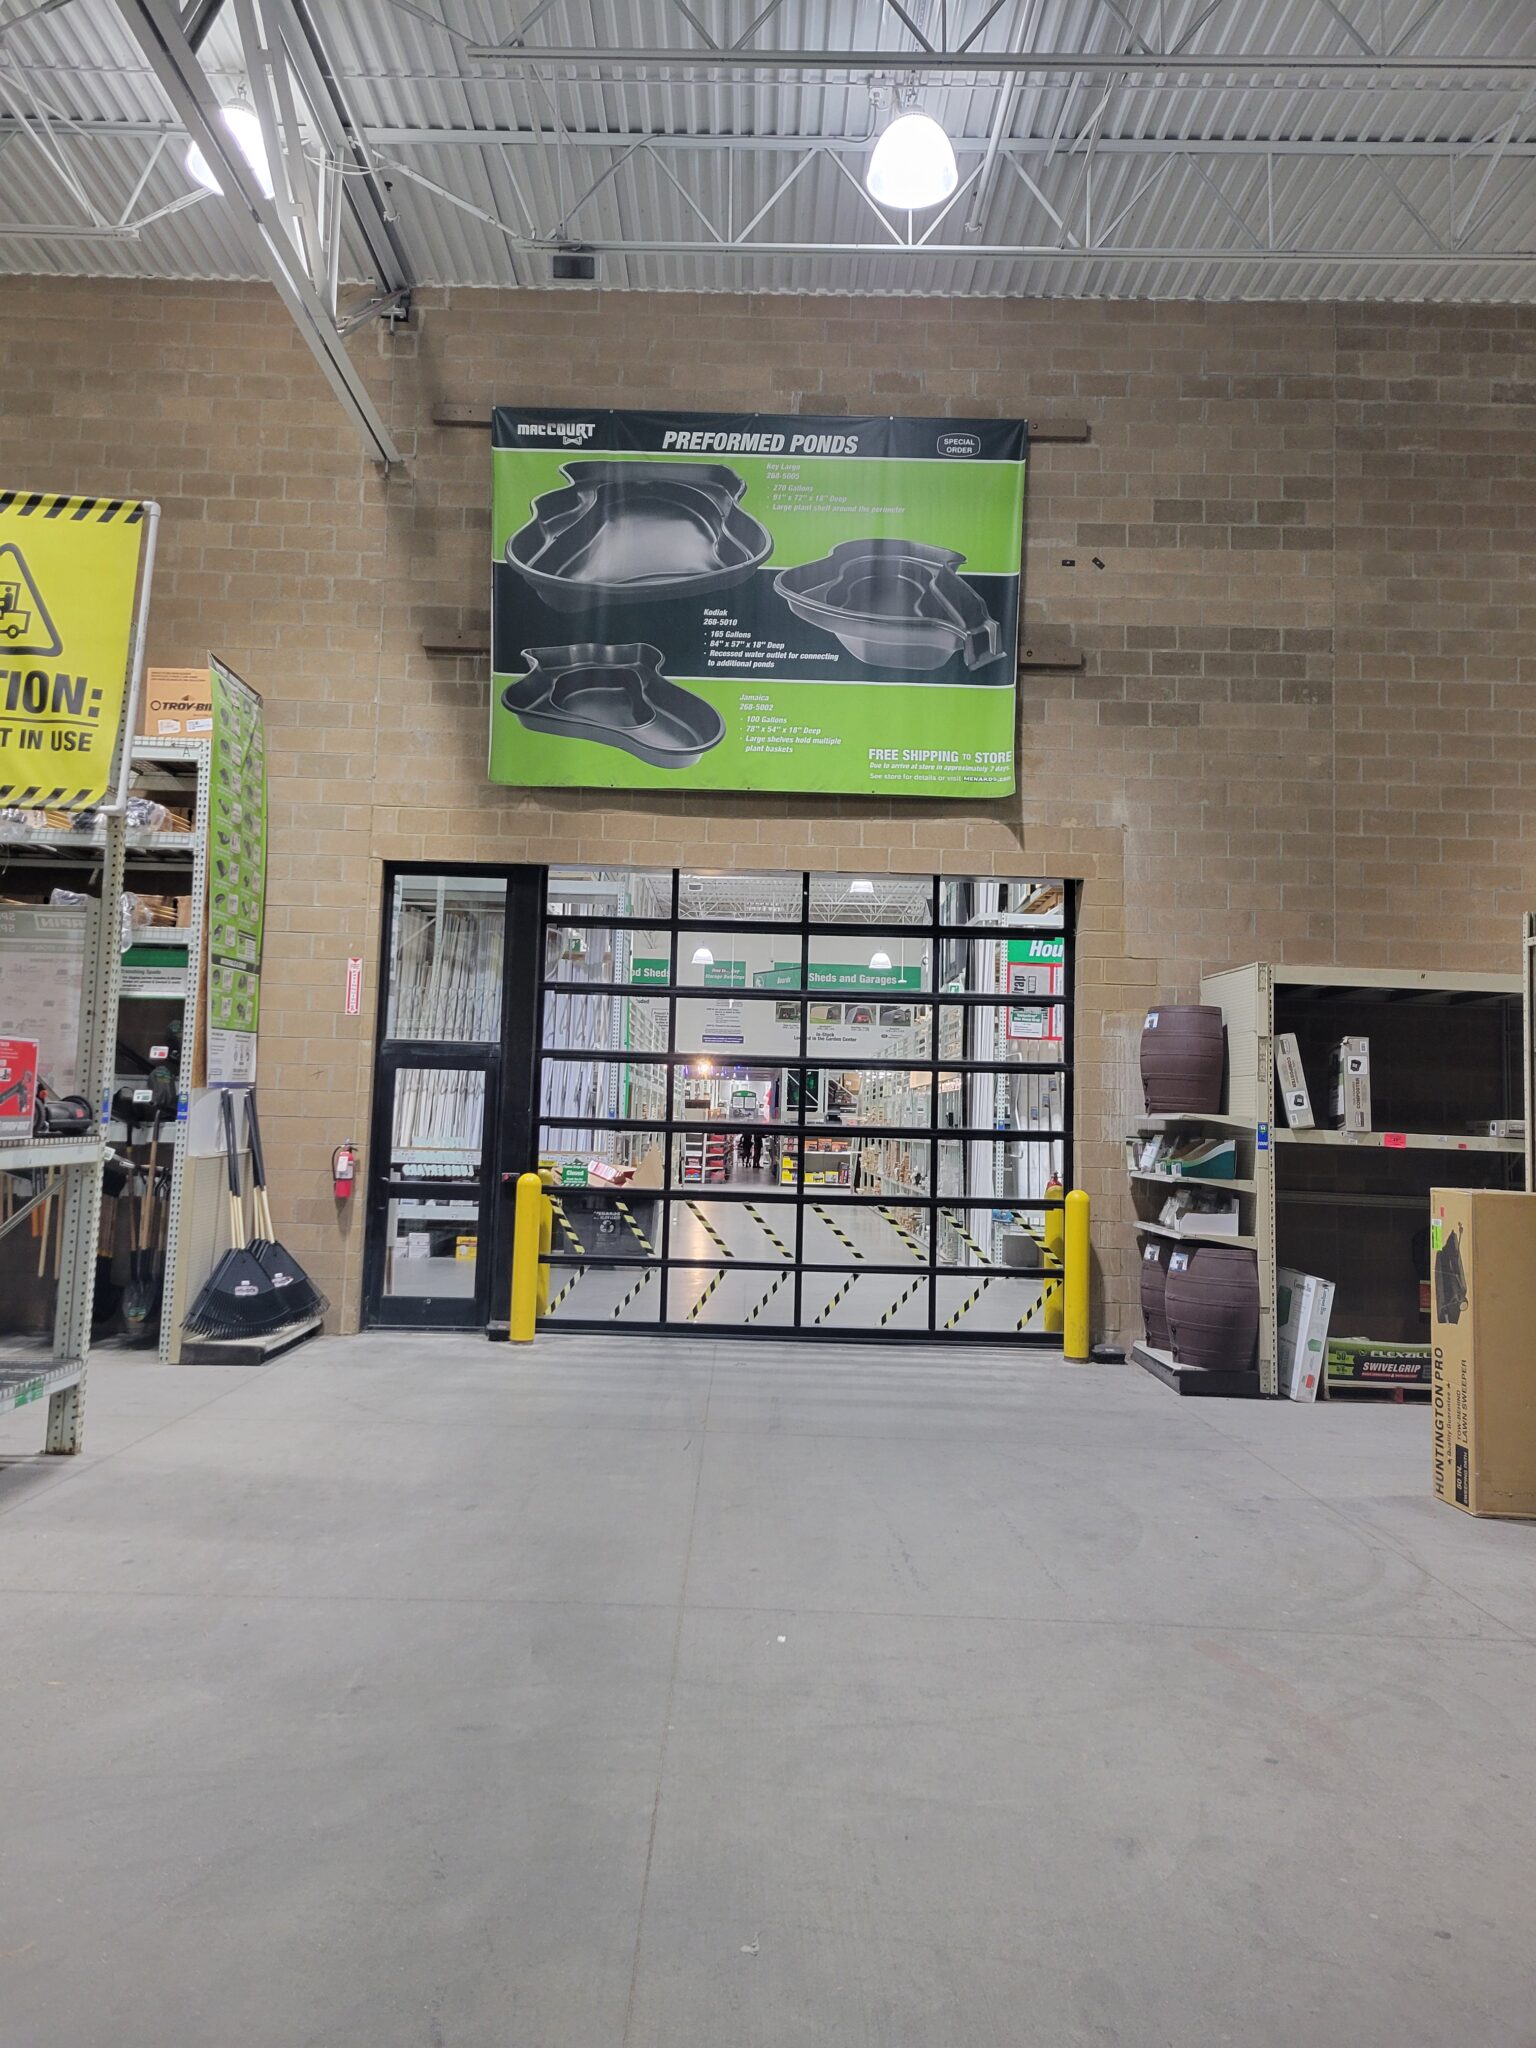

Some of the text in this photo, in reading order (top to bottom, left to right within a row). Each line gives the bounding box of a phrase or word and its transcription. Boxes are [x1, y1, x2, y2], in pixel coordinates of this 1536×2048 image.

[662, 431, 859, 454] PREFORMED PONDS
[943, 438, 976, 446] SPECIAL
[946, 446, 973, 454] ORDER
[766, 463, 780, 471] Key
[788, 485, 813, 493] Gallons
[829, 495, 848, 504] Deep
[772, 503, 905, 514] Large plant shelf around the perimeter
[703, 608, 728, 616] Kodiak
[703, 618, 738, 626] 268-5010
[710, 630, 752, 639] 165 Gallons
[767, 641, 785, 651] Deep
[709, 649, 743, 658] Recessed
[766, 651, 787, 660] outlet
[788, 651, 798, 659] for
[800, 652, 839, 662] connecting
[707, 659, 775, 669] to additional ponds
[739, 703, 774, 711] 268-5002
[746, 715, 787, 724] 100 Gallons
[803, 727, 821, 736] Deep
[19, 728, 43, 750] IN
[51, 730, 93, 752] USE
[745, 735, 766, 744] Large
[795, 736, 811, 744] hold
[812, 737, 842, 746] multiple
[745, 744, 793, 753] plant baskets
[868, 748, 1013, 764] FREE SHIPPING TO STORE
[943, 764, 988, 773] approximately
[869, 772, 882, 780] See
[808, 972, 897, 986] Sheds and Garages
[1286, 1057, 1297, 1088] COMPOSTER
[1362, 1361, 1422, 1373] SWIVELGRIP
[1434, 1347, 1444, 1495] HUNTINGTON PRO
[1461, 1413, 1469, 1443] LAWN
